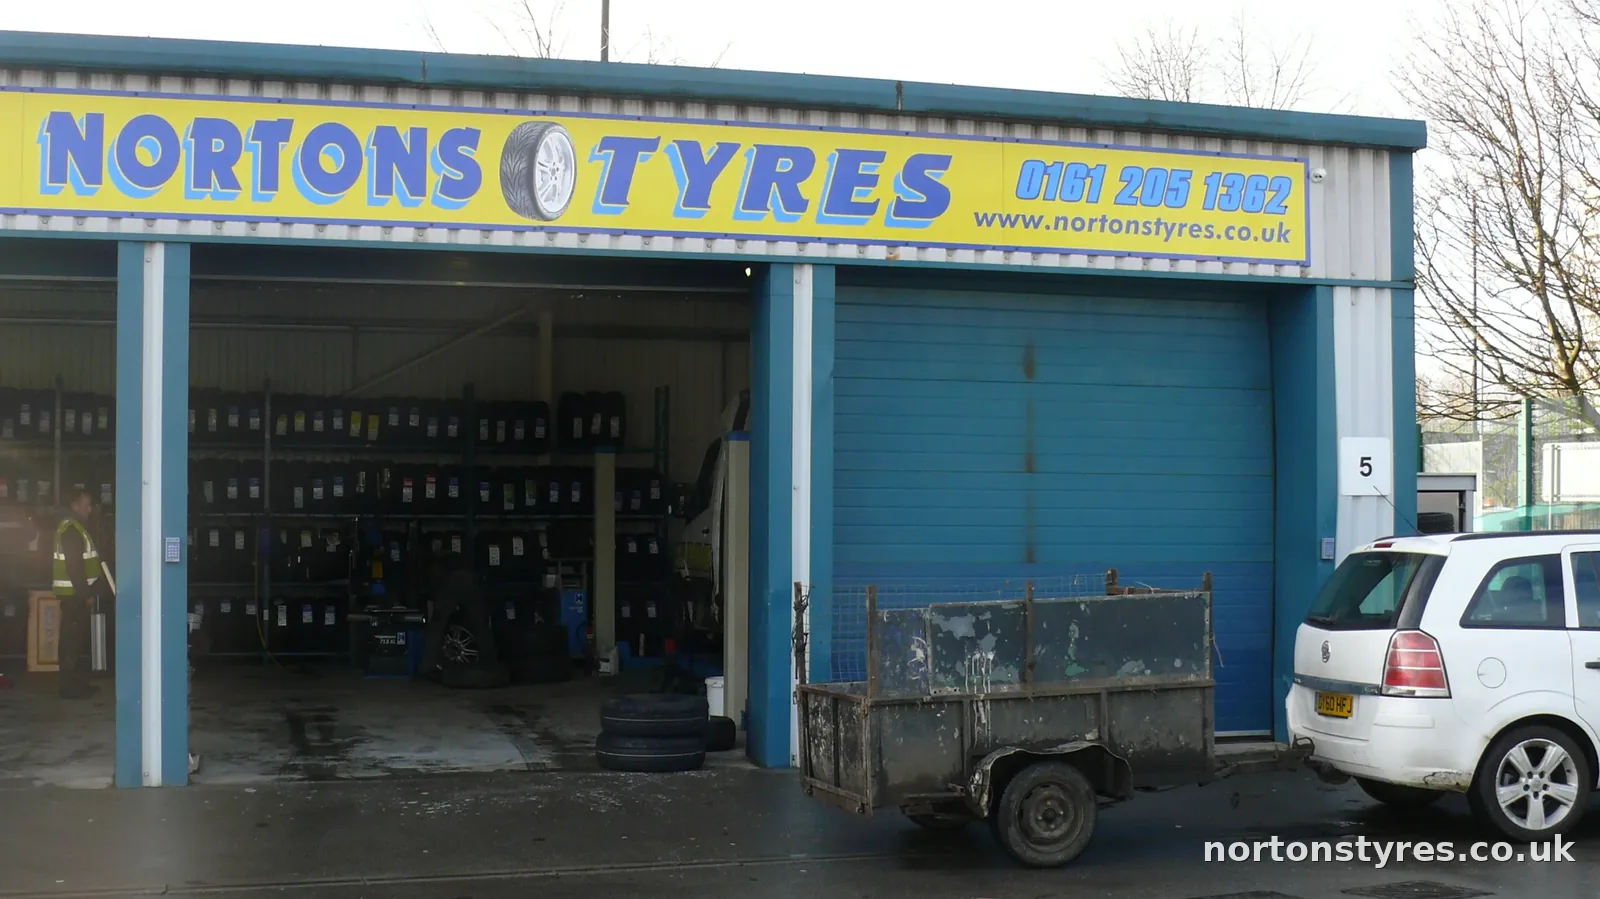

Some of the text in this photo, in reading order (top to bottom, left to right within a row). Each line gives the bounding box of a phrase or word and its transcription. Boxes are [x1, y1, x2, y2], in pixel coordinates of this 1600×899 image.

[38, 111, 953, 229] NORTONS TYRES
[1015, 159, 1292, 215] 0161 205 1362
[973, 211, 1291, 244] www.nortonstyres.co.uk
[1360, 456, 1372, 477] 5
